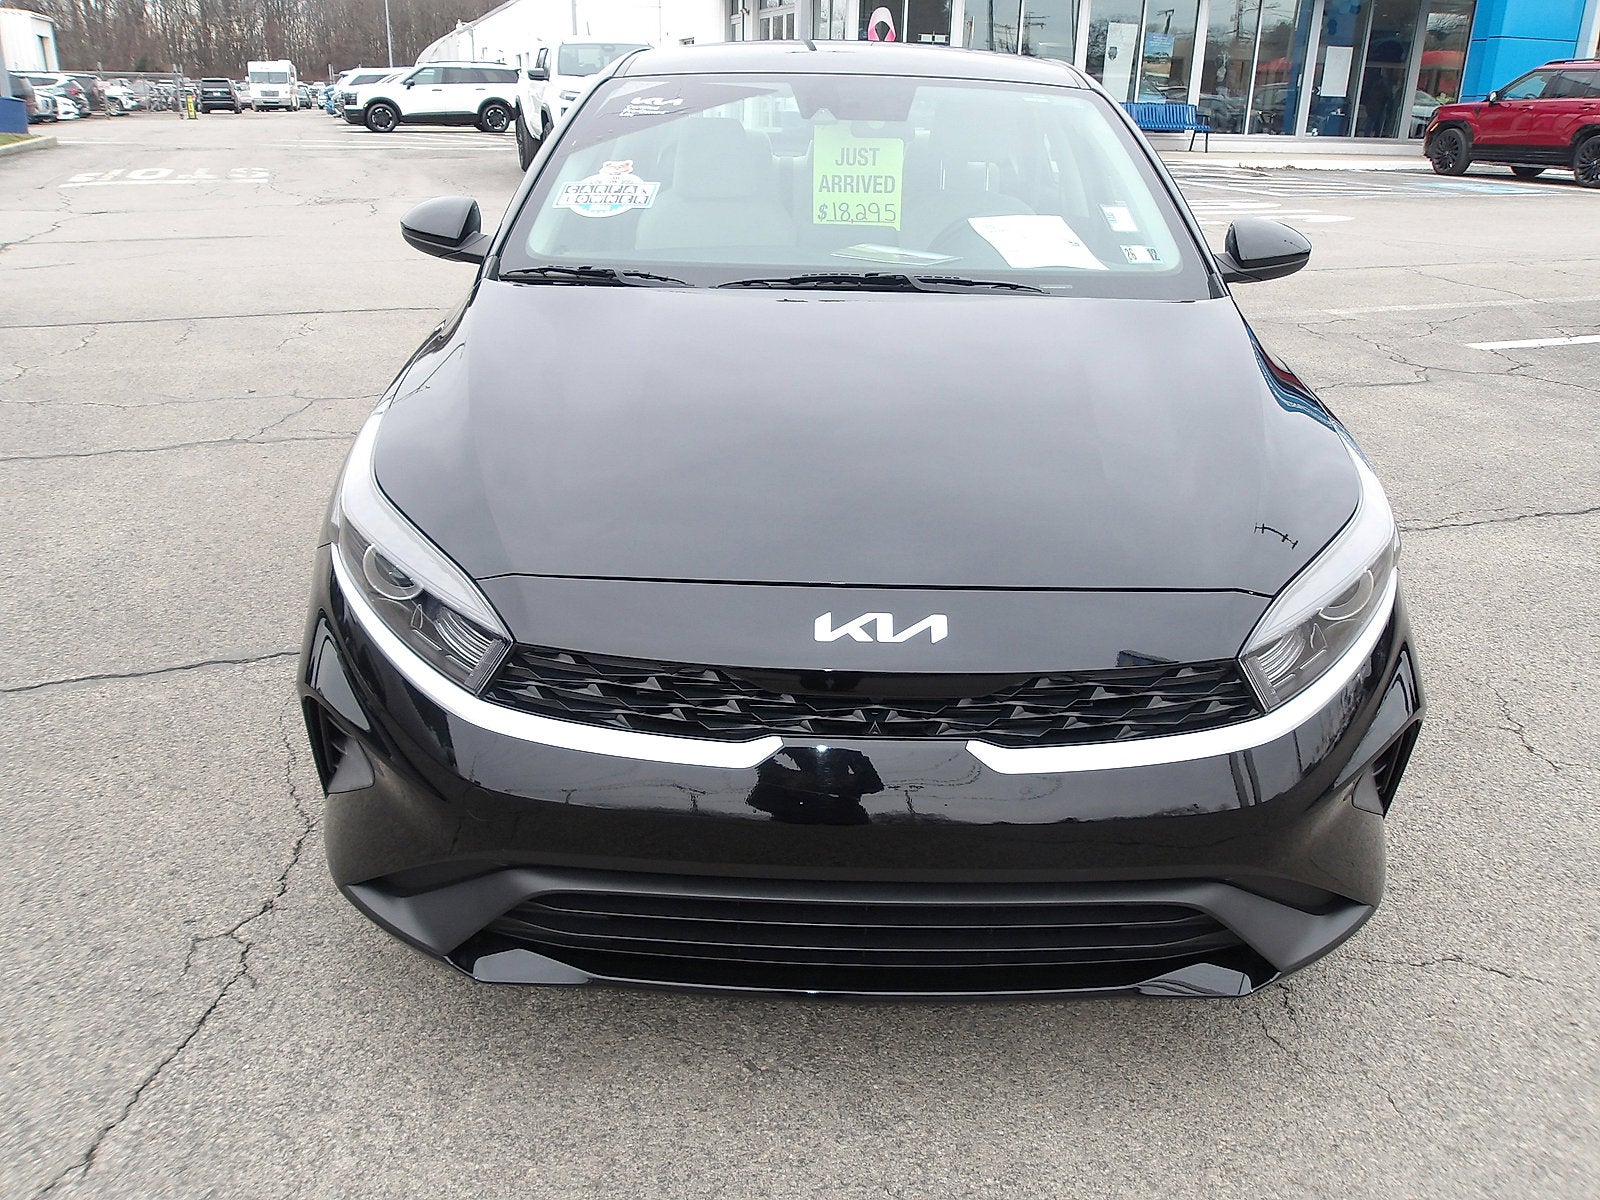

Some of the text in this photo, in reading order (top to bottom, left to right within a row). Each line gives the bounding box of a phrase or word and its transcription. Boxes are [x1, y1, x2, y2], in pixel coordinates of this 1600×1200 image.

[835, 147, 880, 166] JUST
[818, 174, 896, 193] ARRIVED
[817, 202, 896, 223] $18,295
[1146, 248, 1161, 261] 12
[814, 611, 948, 644] KIA
